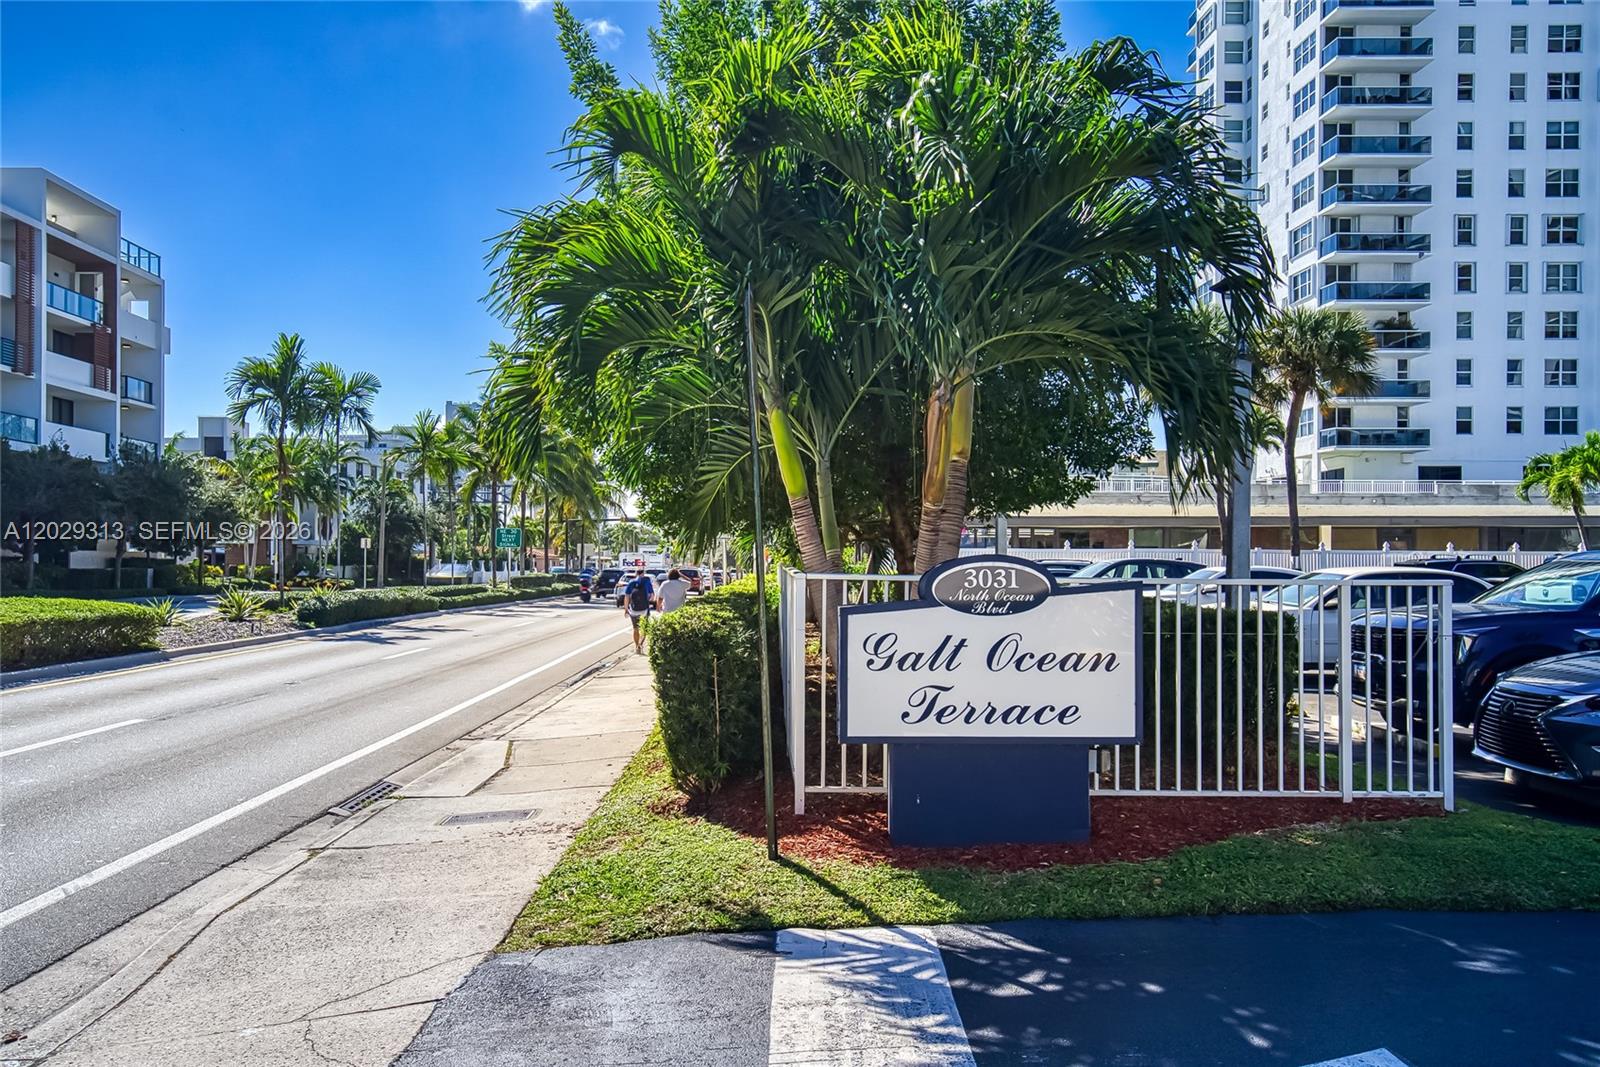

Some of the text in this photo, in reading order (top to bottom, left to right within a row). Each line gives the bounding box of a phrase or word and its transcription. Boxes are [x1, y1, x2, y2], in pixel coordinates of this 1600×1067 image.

[964, 568, 1020, 589] 3031
[949, 588, 1035, 602] North Ocean
[971, 602, 1013, 614] Blvd.
[863, 632, 1120, 672] Galt Ocean
[901, 684, 1081, 725] Terrace
